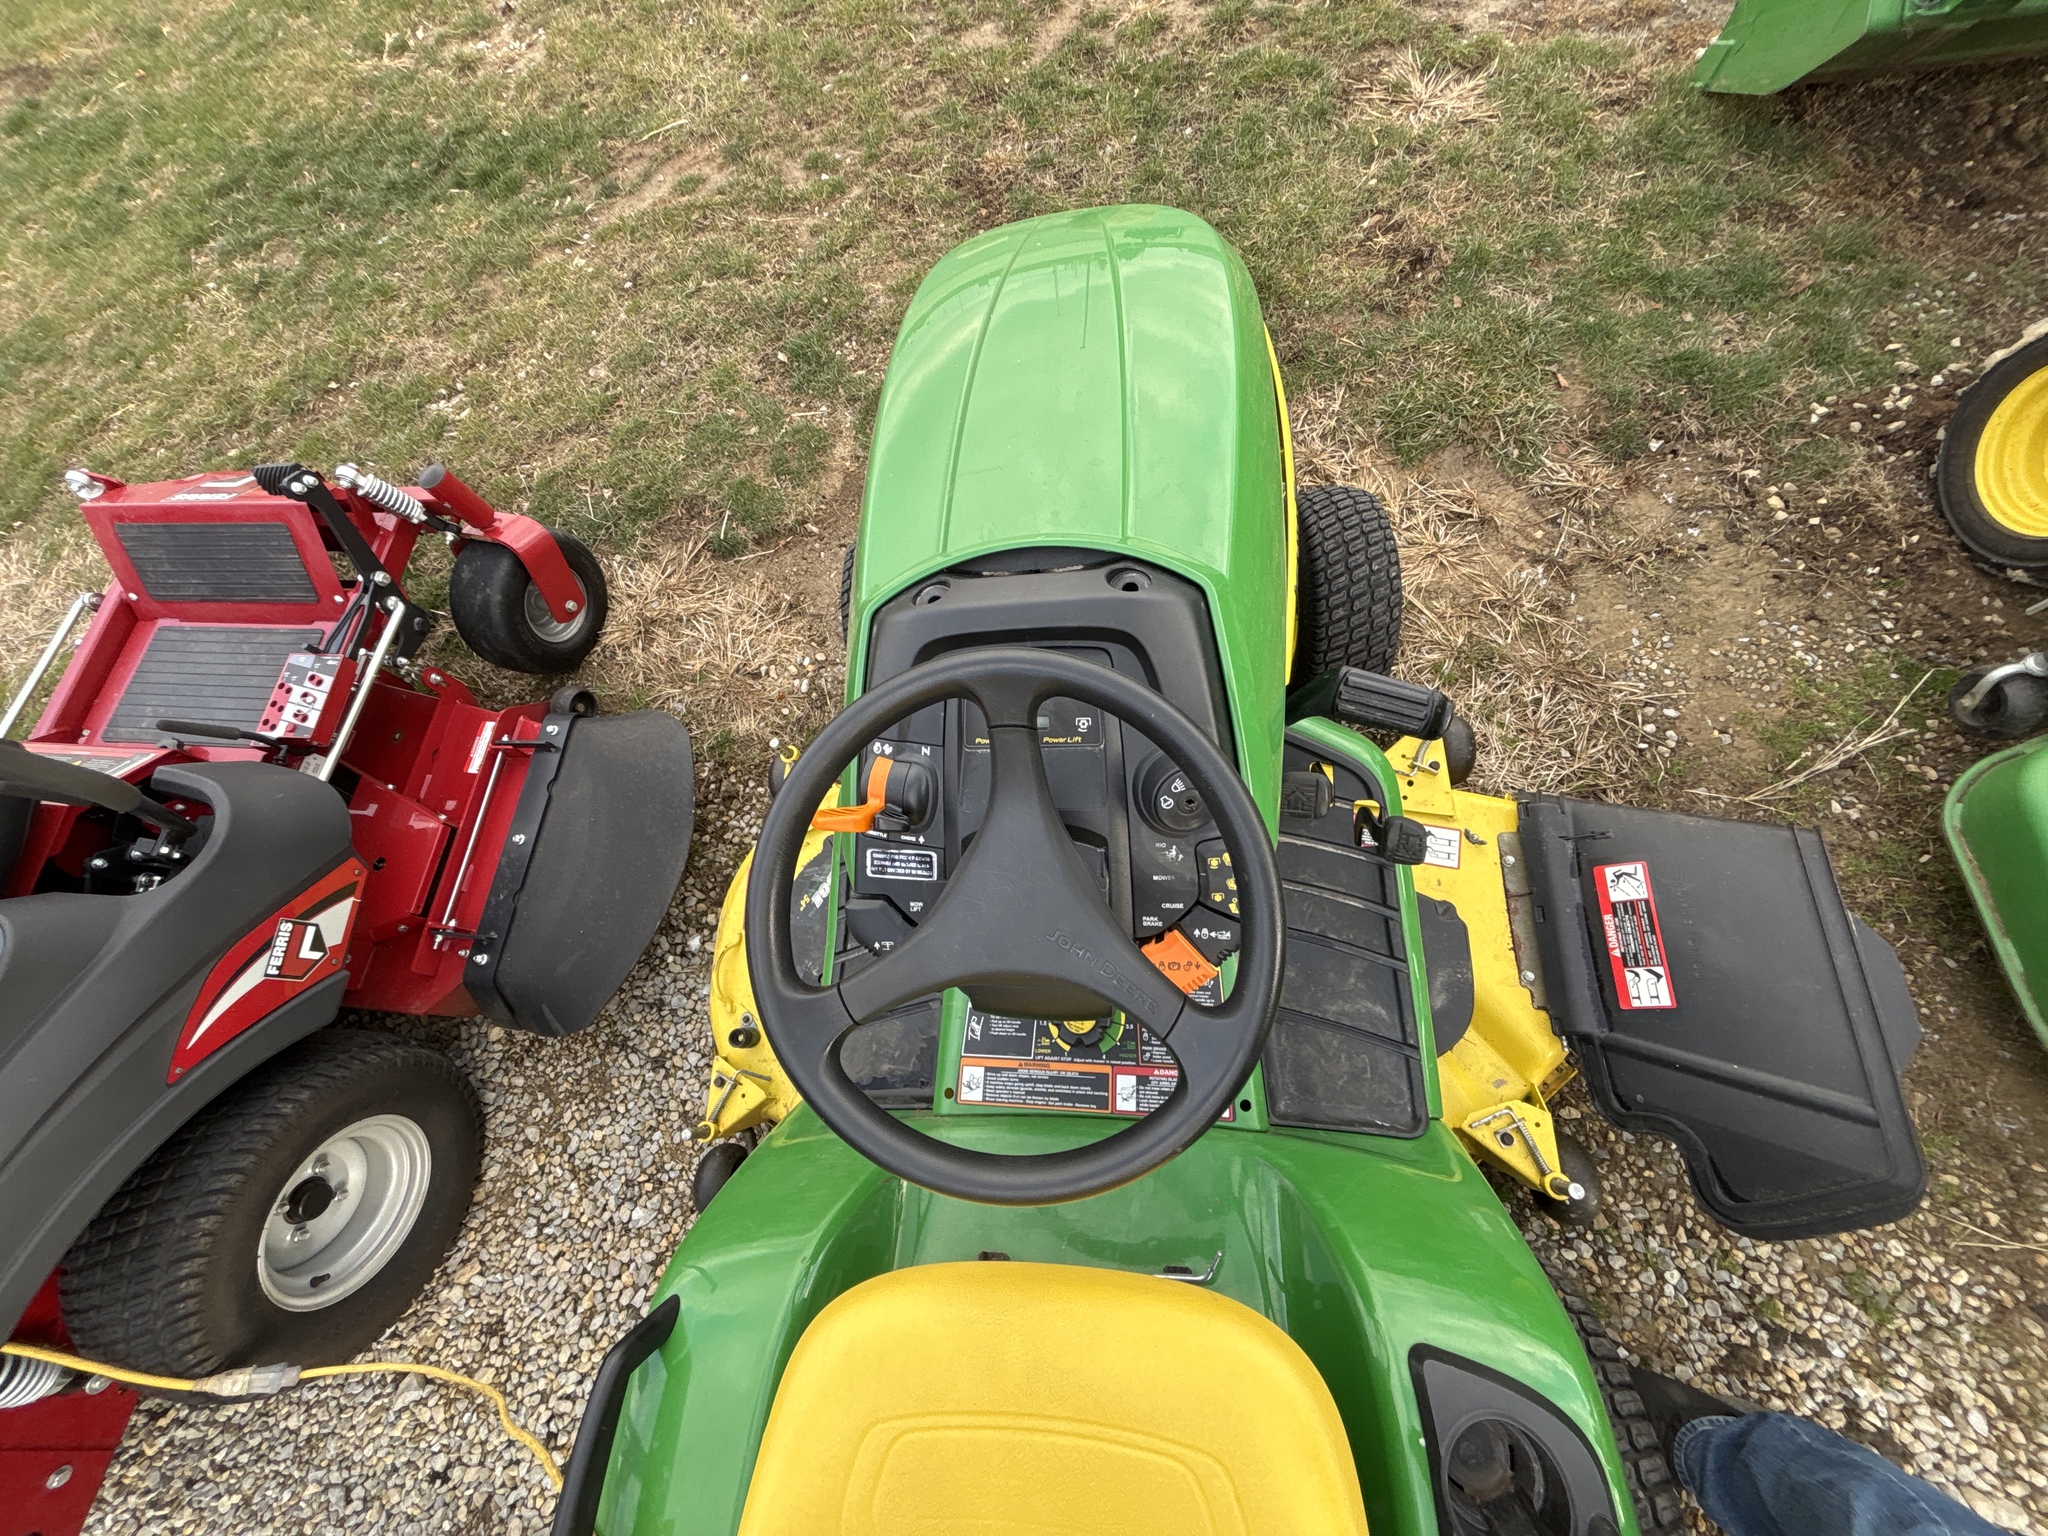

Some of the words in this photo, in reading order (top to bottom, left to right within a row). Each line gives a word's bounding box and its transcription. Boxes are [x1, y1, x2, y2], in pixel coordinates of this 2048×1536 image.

[922, 746, 930, 756] N
[266, 921, 294, 975] FERRIS
[1604, 914, 1619, 948] DANGER
[1046, 930, 1098, 967] JOHN
[1100, 961, 1159, 1014] DEERE
